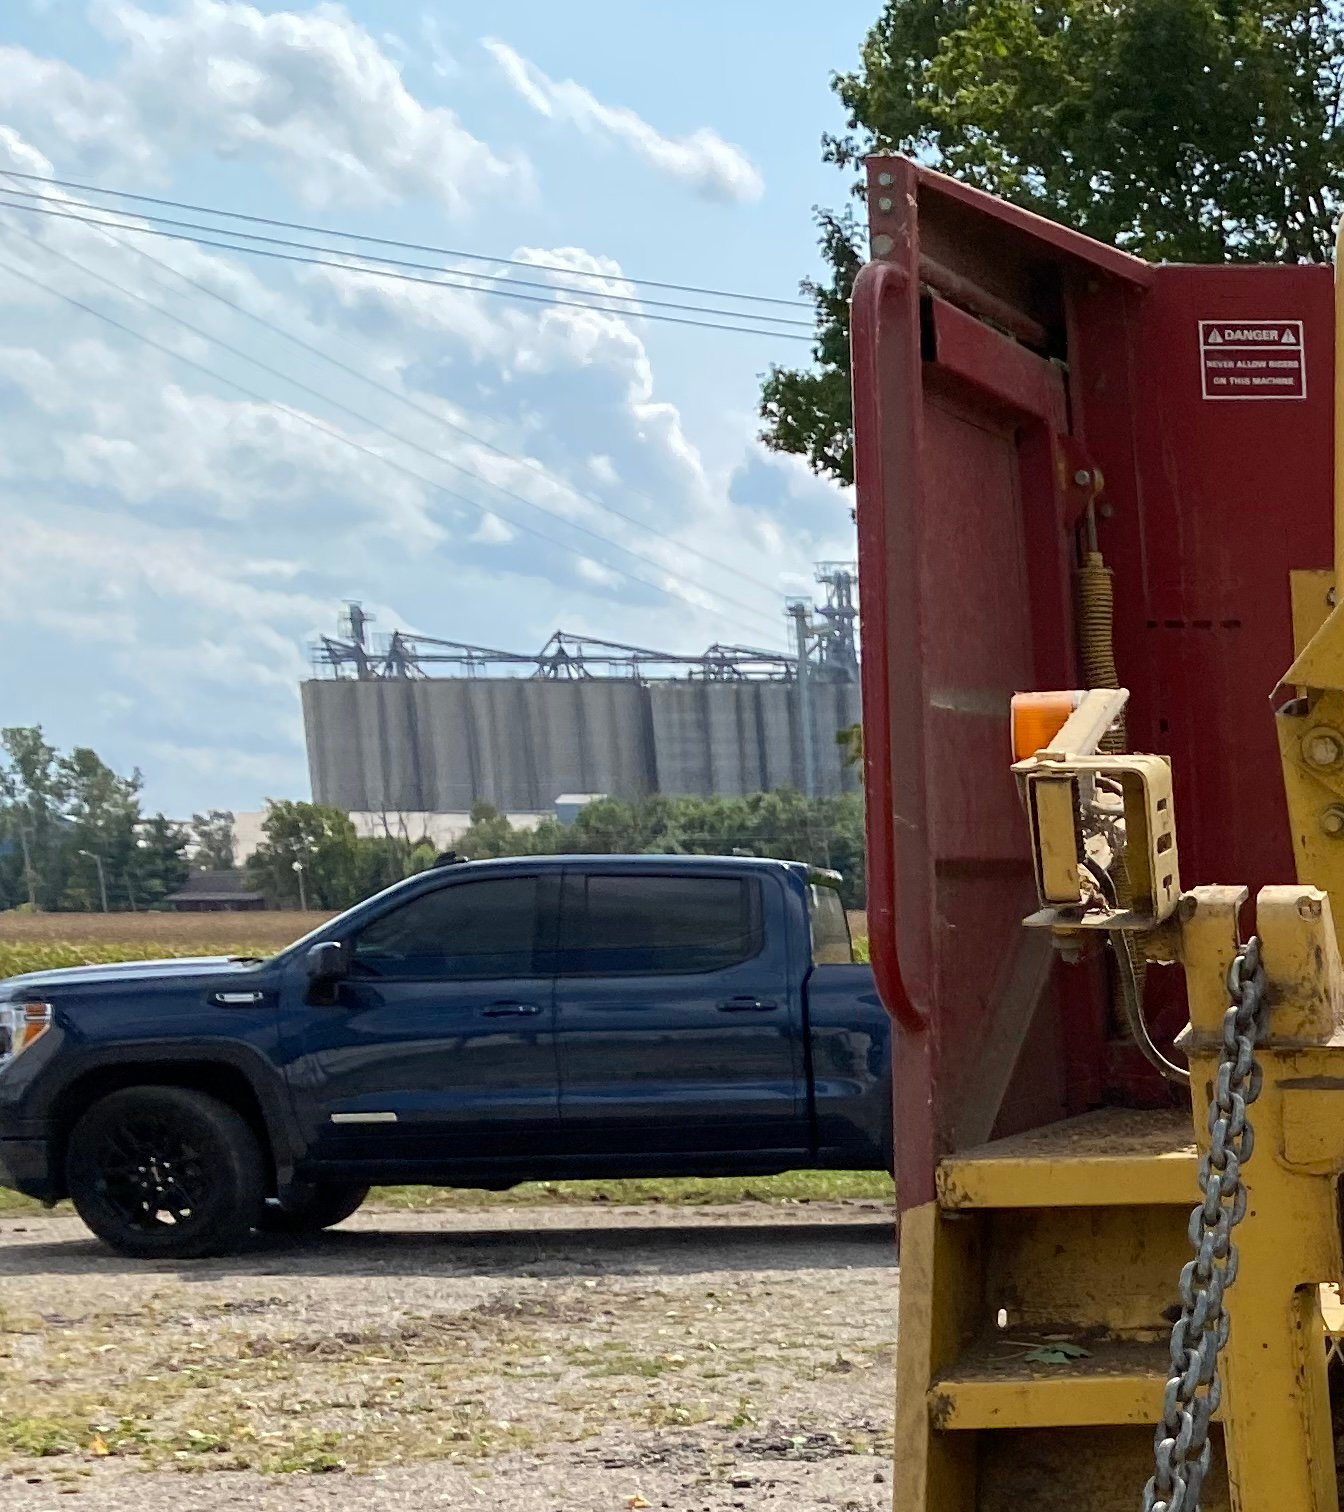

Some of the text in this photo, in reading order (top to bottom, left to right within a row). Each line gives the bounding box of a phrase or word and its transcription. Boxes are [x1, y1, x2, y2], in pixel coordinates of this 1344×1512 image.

[1224, 329, 1278, 341] DANGER
[1206, 360, 1234, 368] NEVER
[1236, 360, 1266, 368] ALLOW
[1229, 376, 1250, 385] THIS
